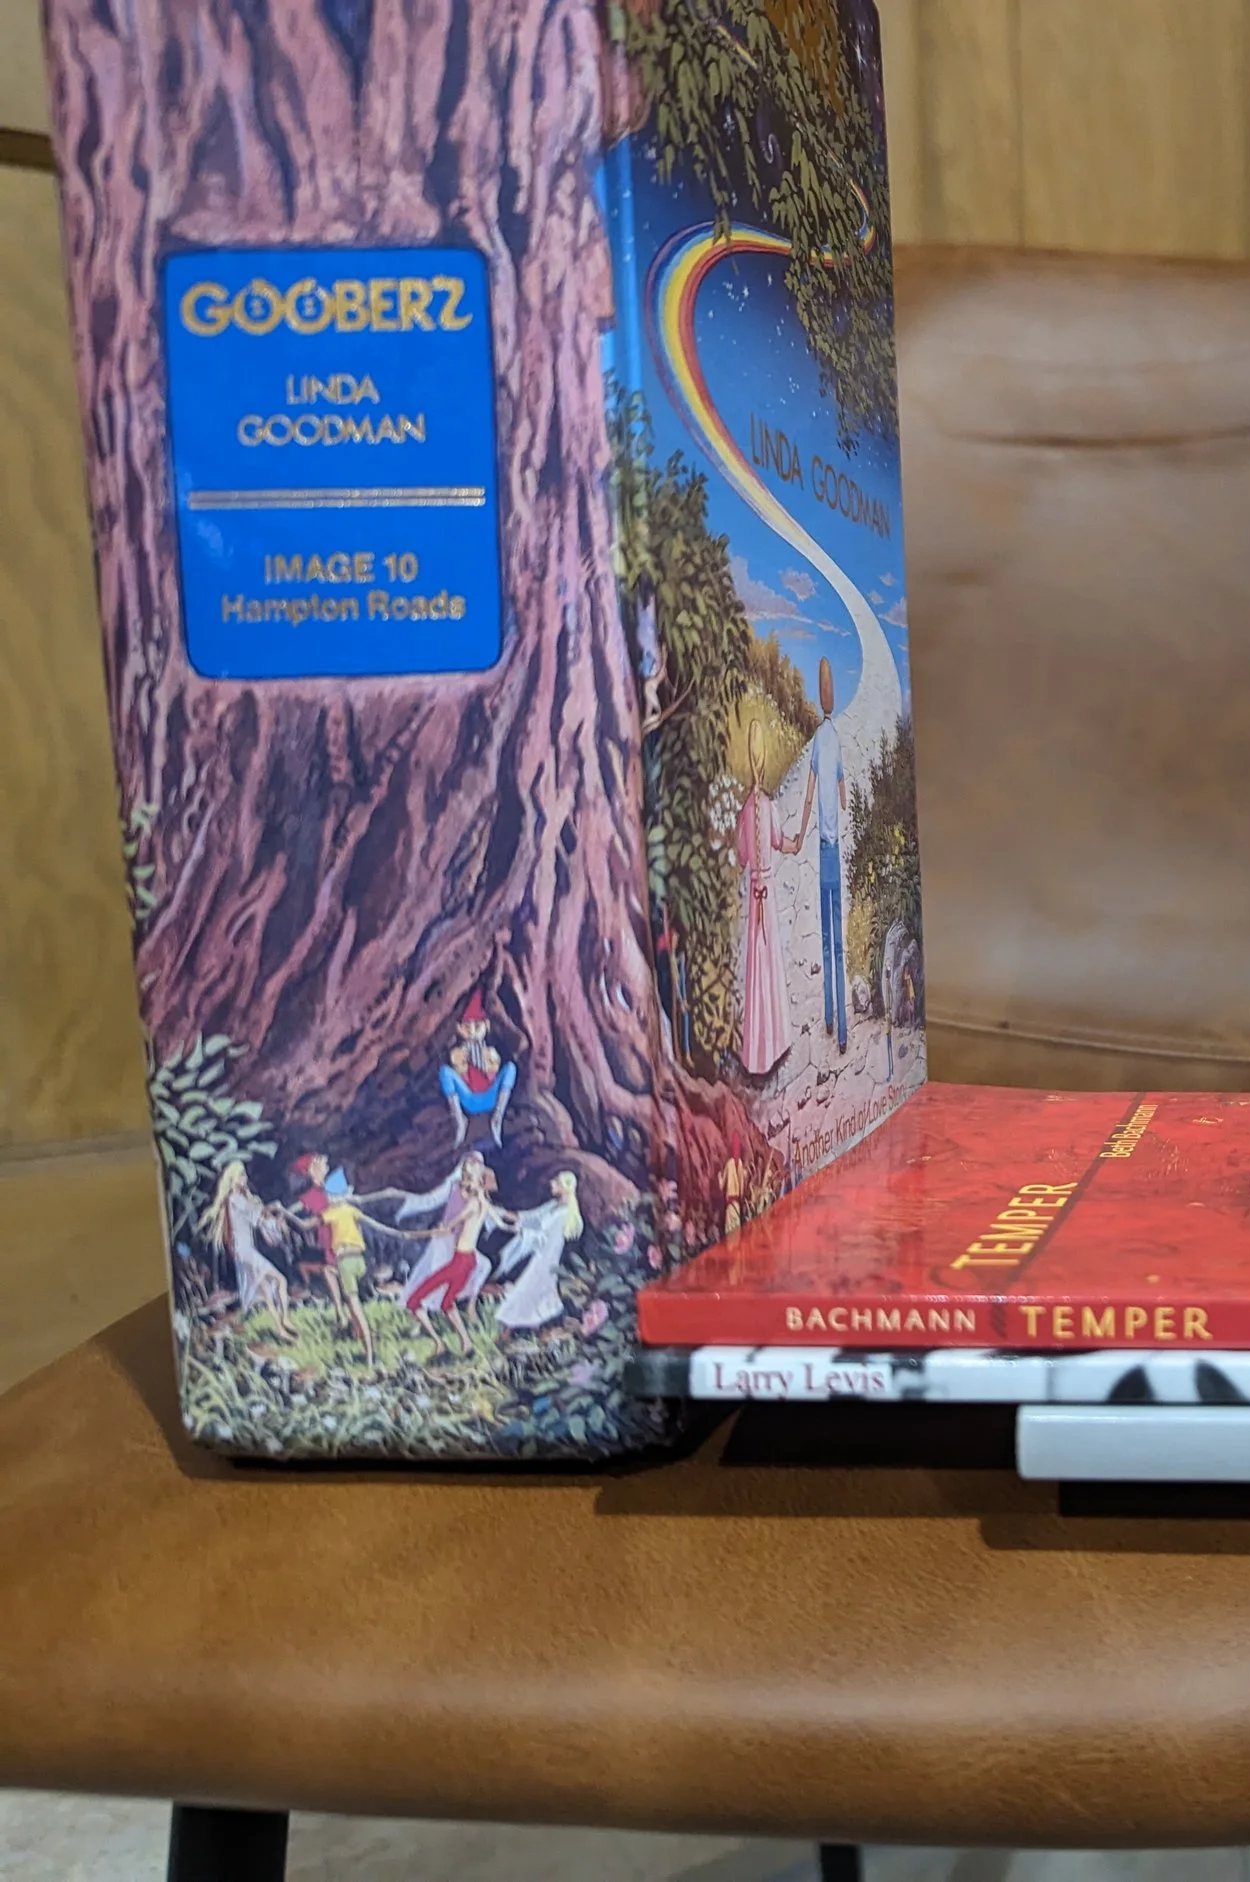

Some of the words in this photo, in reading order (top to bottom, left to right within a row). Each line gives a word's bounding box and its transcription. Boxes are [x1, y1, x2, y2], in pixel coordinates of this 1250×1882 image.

[181, 276, 474, 335] GOOBERZ
[285, 374, 381, 405] LINDA
[237, 413, 426, 447] GOODMAN
[751, 412, 804, 491] LINDA
[811, 454, 890, 540] GOODMAN
[264, 551, 375, 584] IMAGE
[382, 552, 419, 583] 10
[222, 592, 359, 627] Hampton
[367, 589, 467, 622] Roads
[793, 1128, 833, 1168] Another
[835, 1107, 857, 1144] Kind
[867, 1096, 888, 1124] Love
[1111, 1104, 1159, 1140] Bachmann
[1099, 1141, 1139, 1159] Beth
[950, 1182, 1079, 1270] TEMPER
[785, 1306, 977, 1333] BACHMANN
[1019, 1305, 1214, 1341] TEMPER
[713, 1362, 794, 1396] Larry
[804, 1361, 887, 1393] Levis
